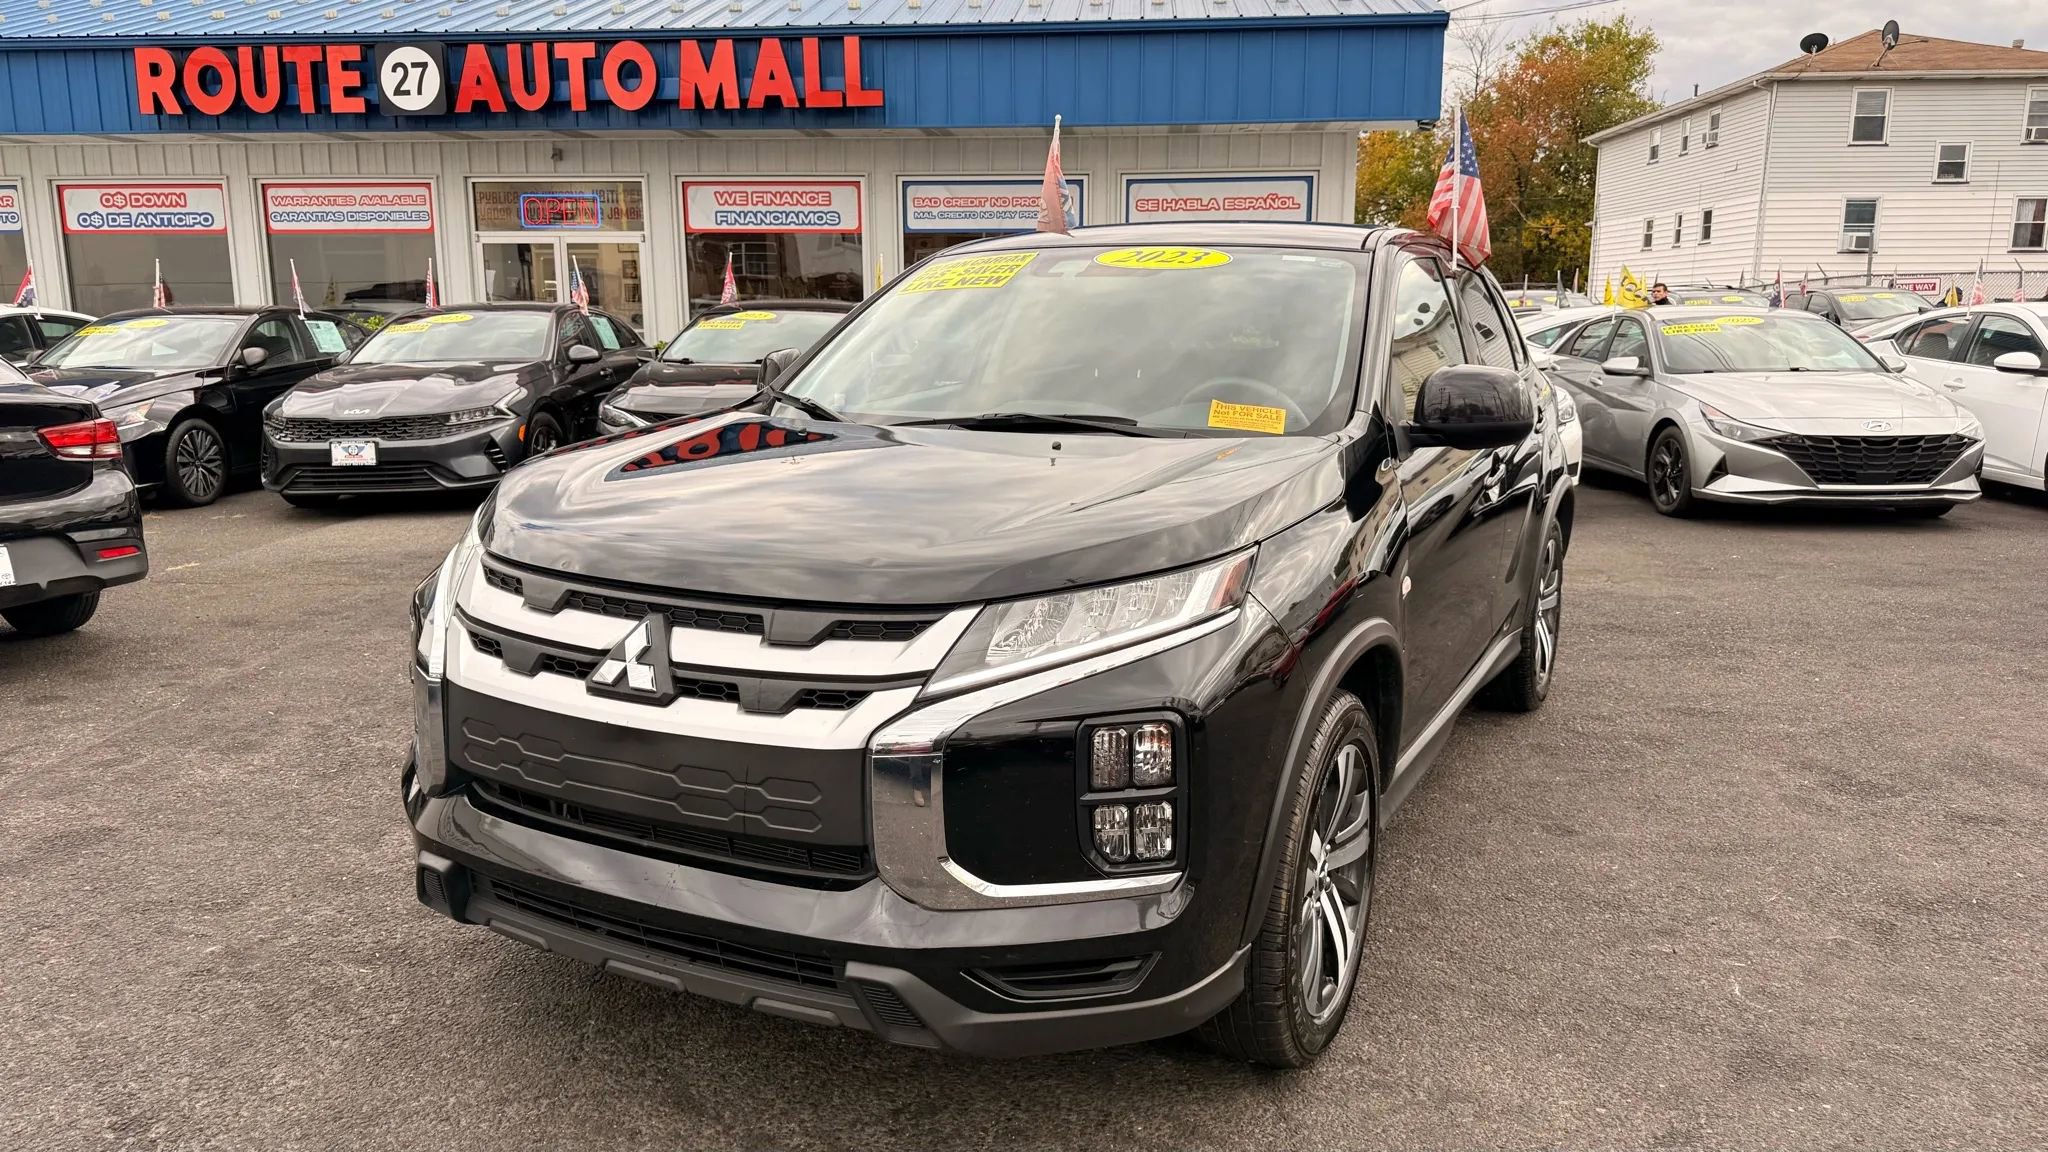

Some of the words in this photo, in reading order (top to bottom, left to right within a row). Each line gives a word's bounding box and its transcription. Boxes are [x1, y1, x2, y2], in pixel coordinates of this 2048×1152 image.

[134, 45, 366, 115] ROUTE
[390, 61, 430, 97] 27
[455, 40, 658, 113] AUTO
[678, 36, 885, 110] MALL
[129, 192, 187, 207] DOWN
[271, 195, 356, 206] WARRANTIES
[358, 194, 427, 206] AVAILABLE
[714, 190, 750, 207] WE
[750, 190, 831, 207] FINANCE
[913, 197, 940, 208] BAD
[943, 197, 987, 208] CREDIT
[989, 197, 1010, 208] NO
[1136, 199, 1160, 213] SE
[1162, 197, 1219, 212] HABLA
[1223, 193, 1301, 211] ESPAÑOL
[270, 211, 345, 222] GARANTIAS
[347, 211, 430, 222] DISPONIBLES
[523, 197, 599, 226] OPEN
[715, 209, 841, 227] FINANCIAMOS
[913, 211, 936, 219] MAL
[938, 211, 978, 219] CREDITO
[979, 210, 994, 219] NO
[996, 210, 1016, 219] HAY
[107, 213, 131, 228] DE
[134, 212, 214, 228] ANTICIPO
[1110, 250, 1212, 264] 2023
[952, 275, 1010, 287] NEW
[1915, 283, 1935, 291] WAY
[1215, 402, 1237, 411] THIS
[1240, 406, 1282, 415] VEHICLE
[1232, 410, 1254, 418] FOR
[1256, 413, 1281, 421] SALE
